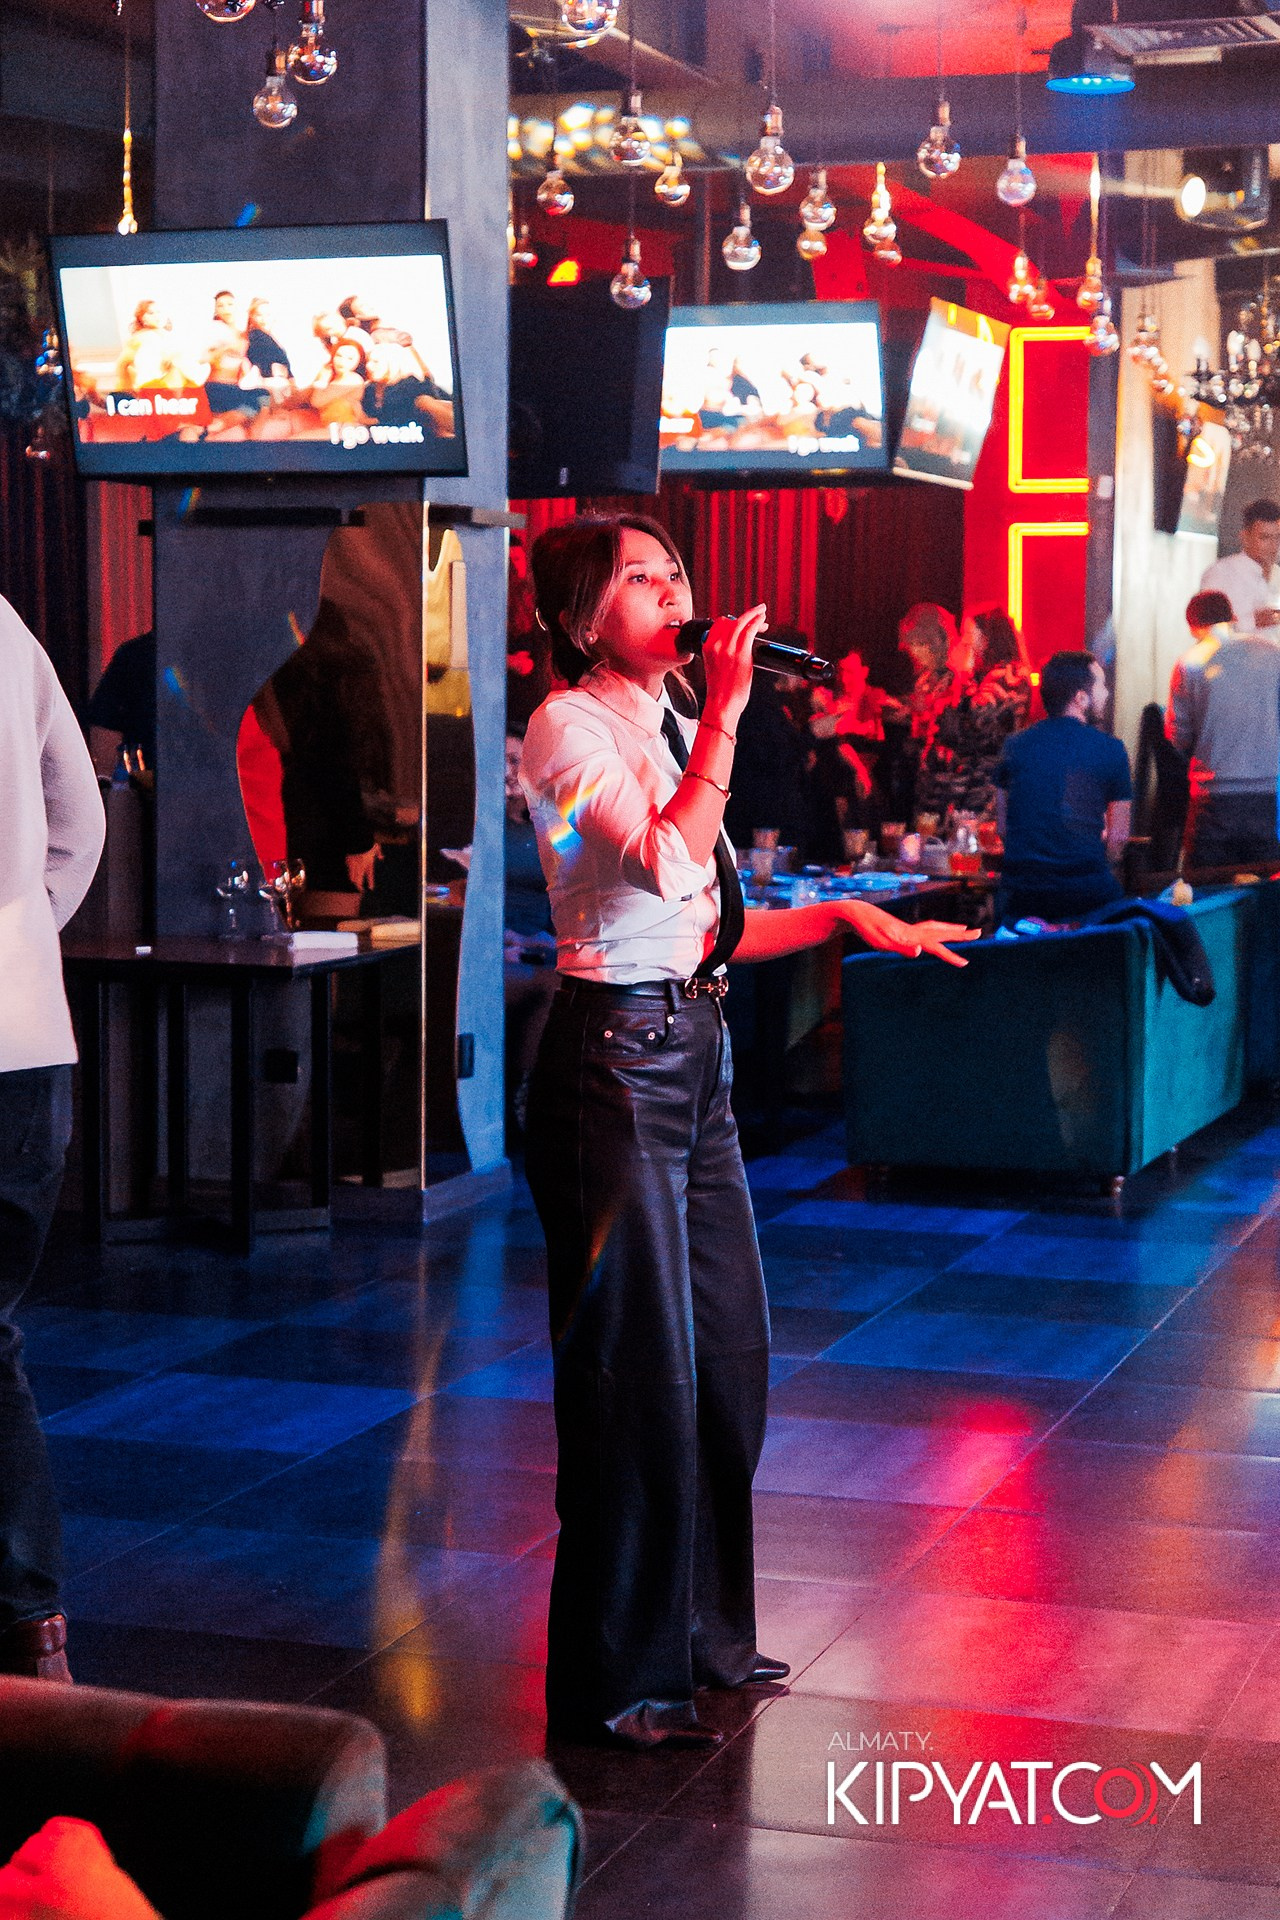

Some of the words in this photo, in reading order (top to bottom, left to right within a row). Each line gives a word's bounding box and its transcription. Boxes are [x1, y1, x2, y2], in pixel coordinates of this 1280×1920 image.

[106, 395, 115, 416] I
[117, 398, 153, 416] can
[154, 394, 199, 416] hear
[329, 422, 340, 445] I
[341, 425, 370, 449] go
[369, 421, 425, 444] weak
